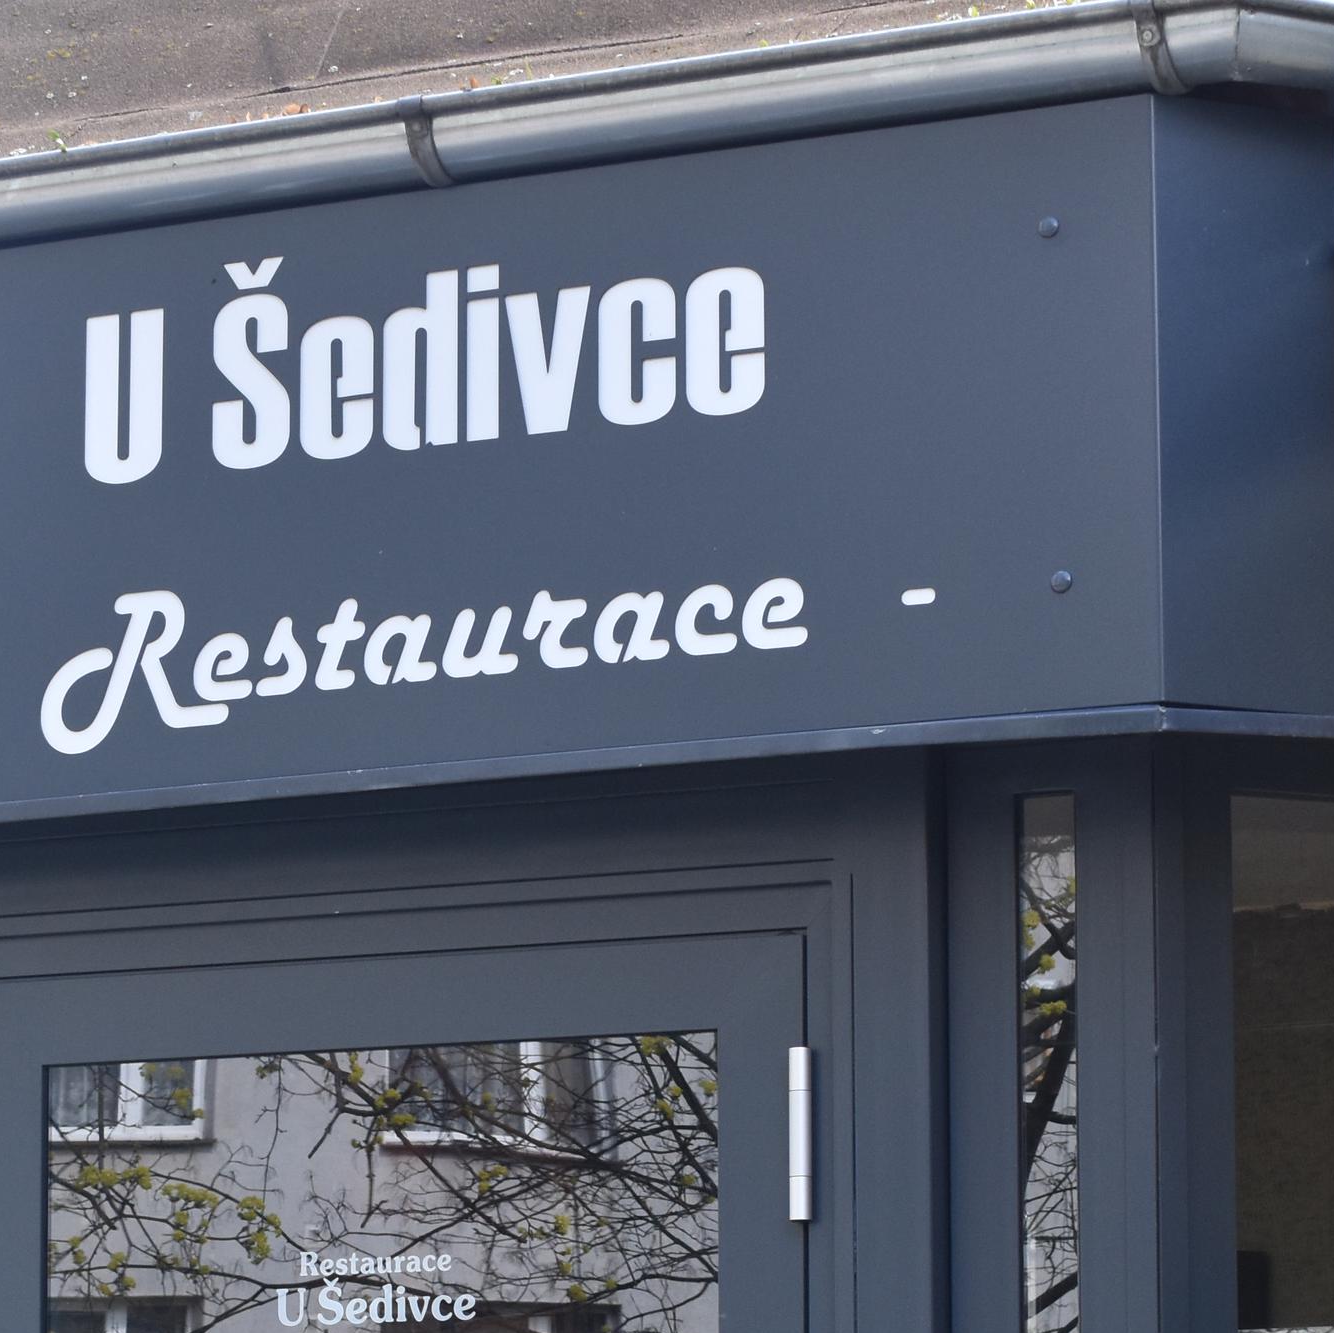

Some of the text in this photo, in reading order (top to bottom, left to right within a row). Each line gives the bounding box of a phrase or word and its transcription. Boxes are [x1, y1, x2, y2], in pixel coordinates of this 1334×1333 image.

[83, 256, 766, 484] U Šedivce
[39, 577, 809, 755] Restaurace
[276, 1277, 476, 1327] U Šedivce
[299, 1251, 452, 1277] Restaurace
